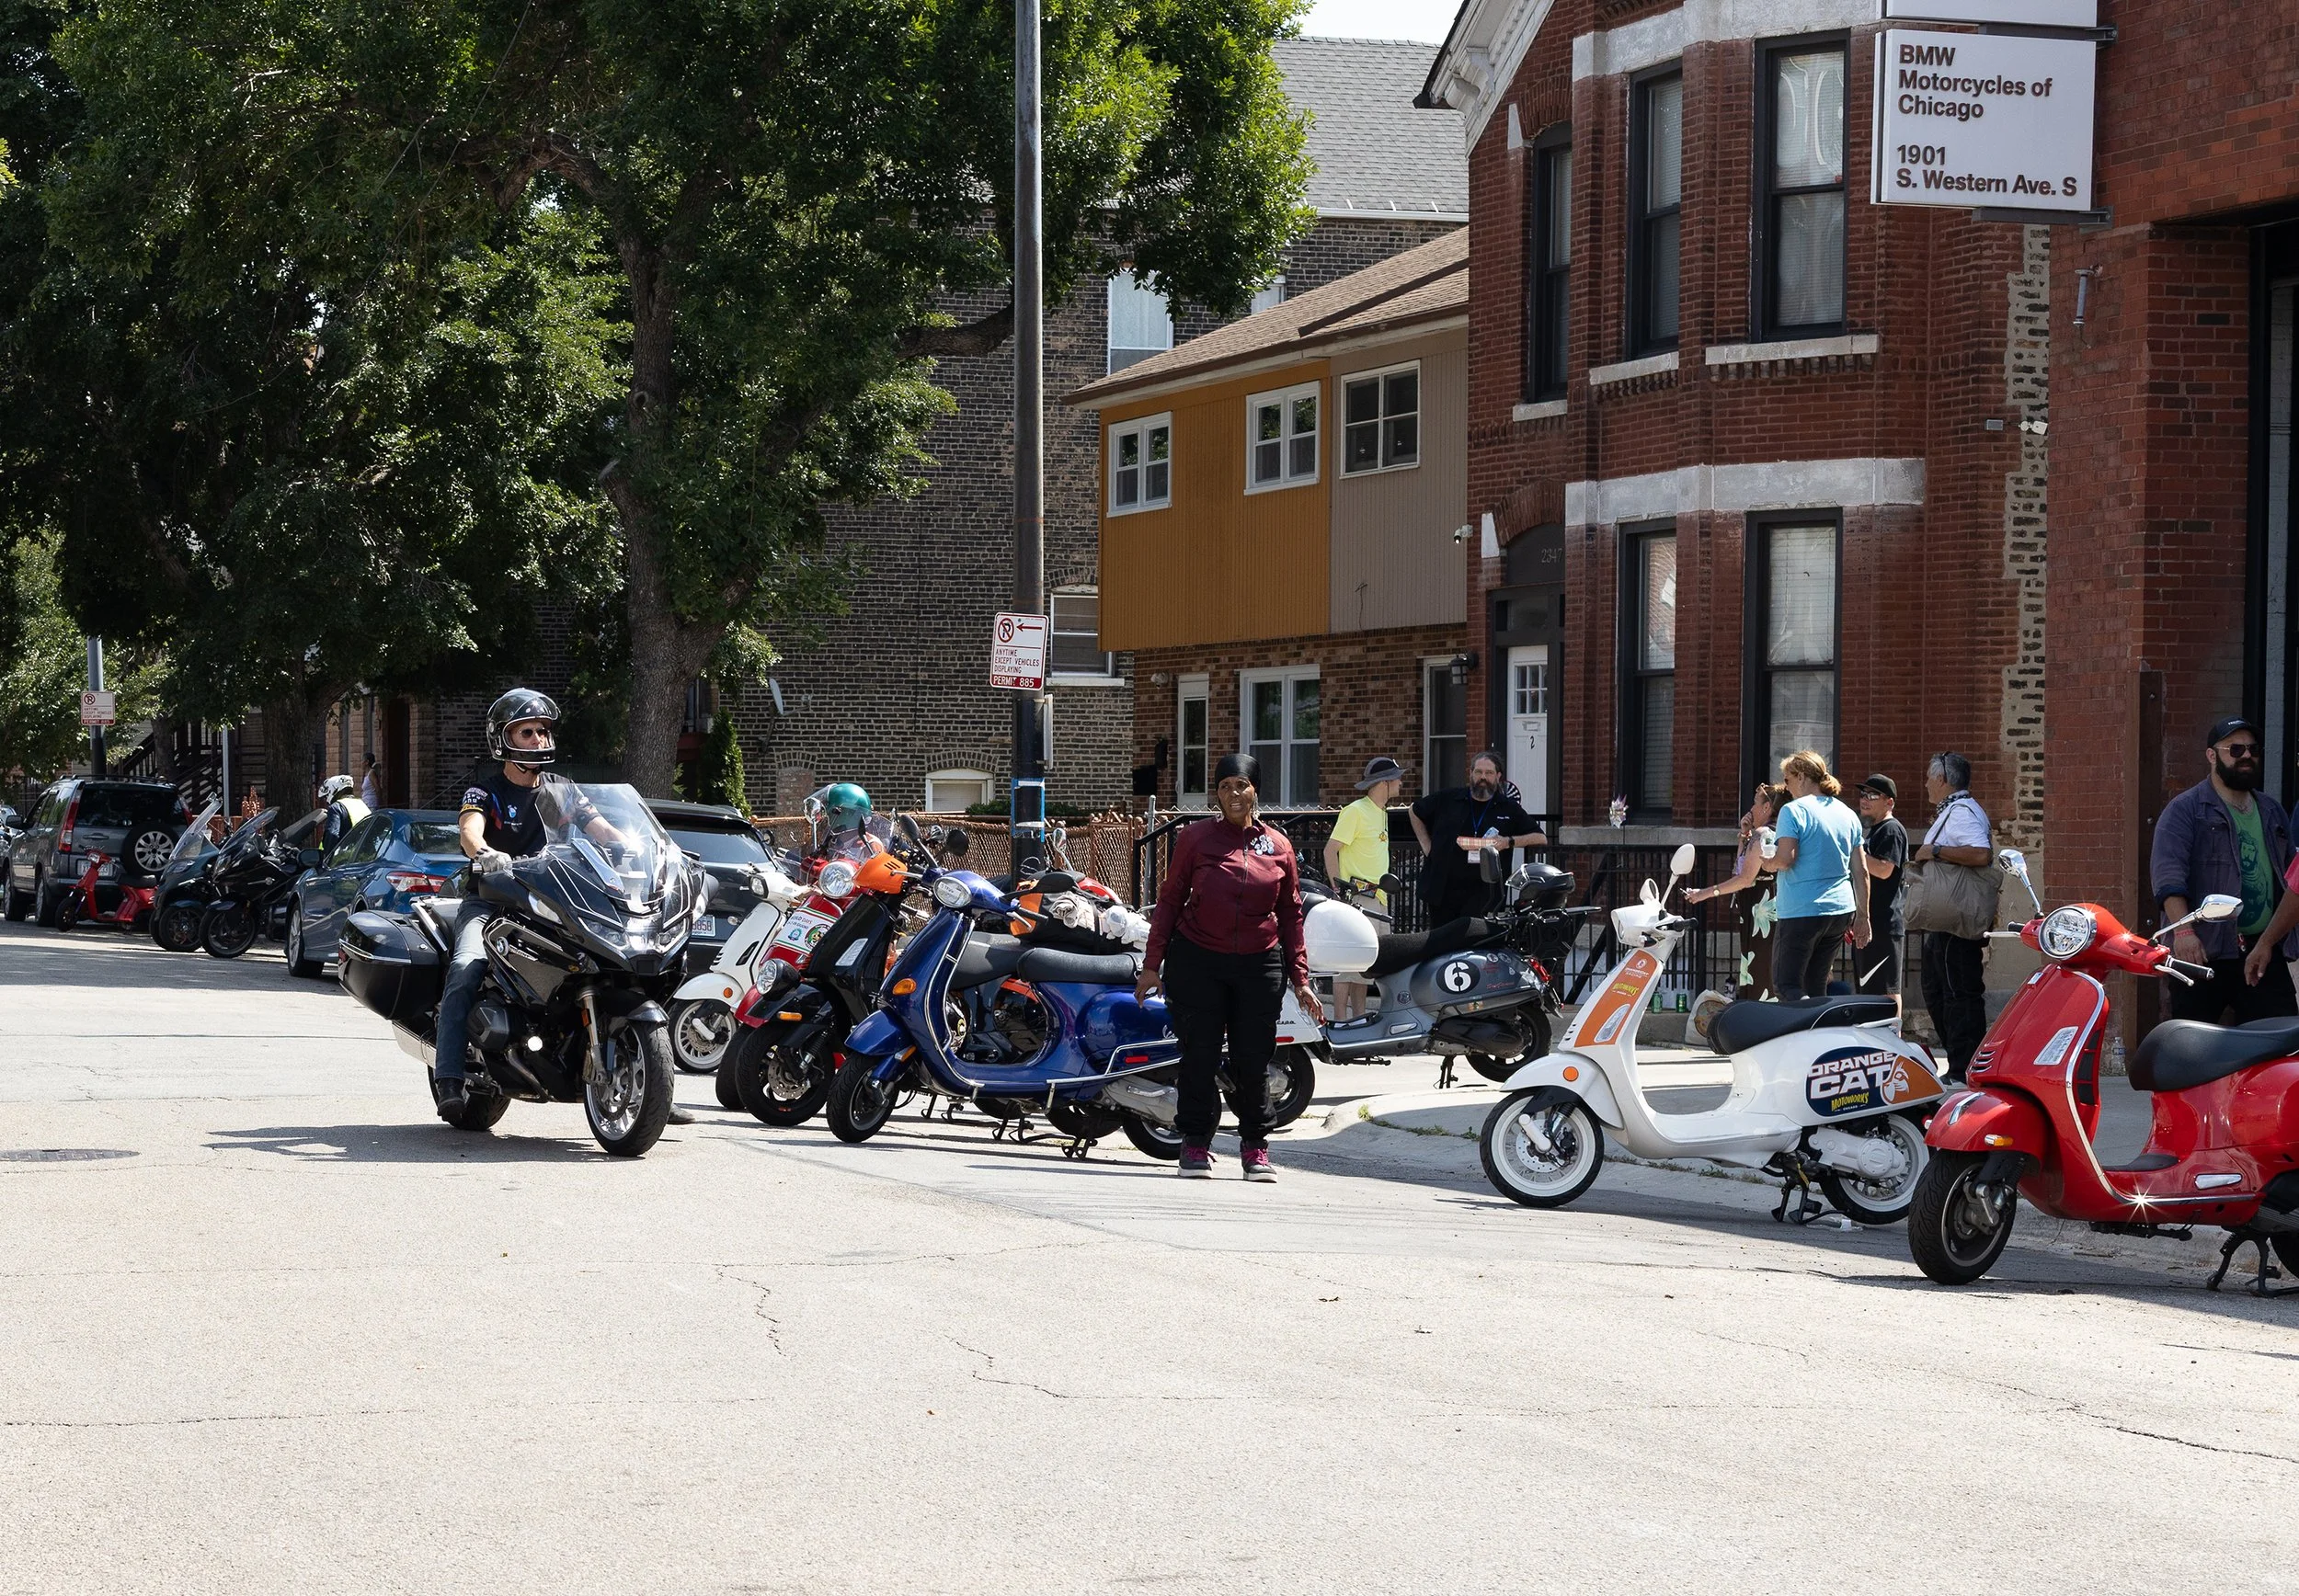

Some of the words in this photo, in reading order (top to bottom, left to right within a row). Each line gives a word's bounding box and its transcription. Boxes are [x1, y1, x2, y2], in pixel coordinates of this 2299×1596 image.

[1899, 44, 1956, 66] BMW
[1898, 69, 2026, 97] Motorcycles
[2030, 78, 2053, 97] of
[1897, 94, 1984, 121] Chicago
[1896, 144, 1946, 165] 1901
[1896, 168, 1917, 188] S.
[1922, 169, 2007, 193] Western
[2012, 175, 2056, 196] Ave.
[2062, 177, 2077, 197] S
[994, 656, 1012, 665] EXCEPT
[1015, 657, 1040, 667] VEHICLES
[995, 648, 1018, 657] ANYTIME
[994, 665, 1022, 674] DISPLAYING
[993, 675, 1017, 686] PERMIT
[1019, 678, 1035, 688] 885
[1444, 962, 1471, 992] 6
[1808, 1051, 1895, 1077] ORANGE
[1810, 1064, 1892, 1100] CAT
[1831, 1091, 1870, 1112] MOTOWORKS
